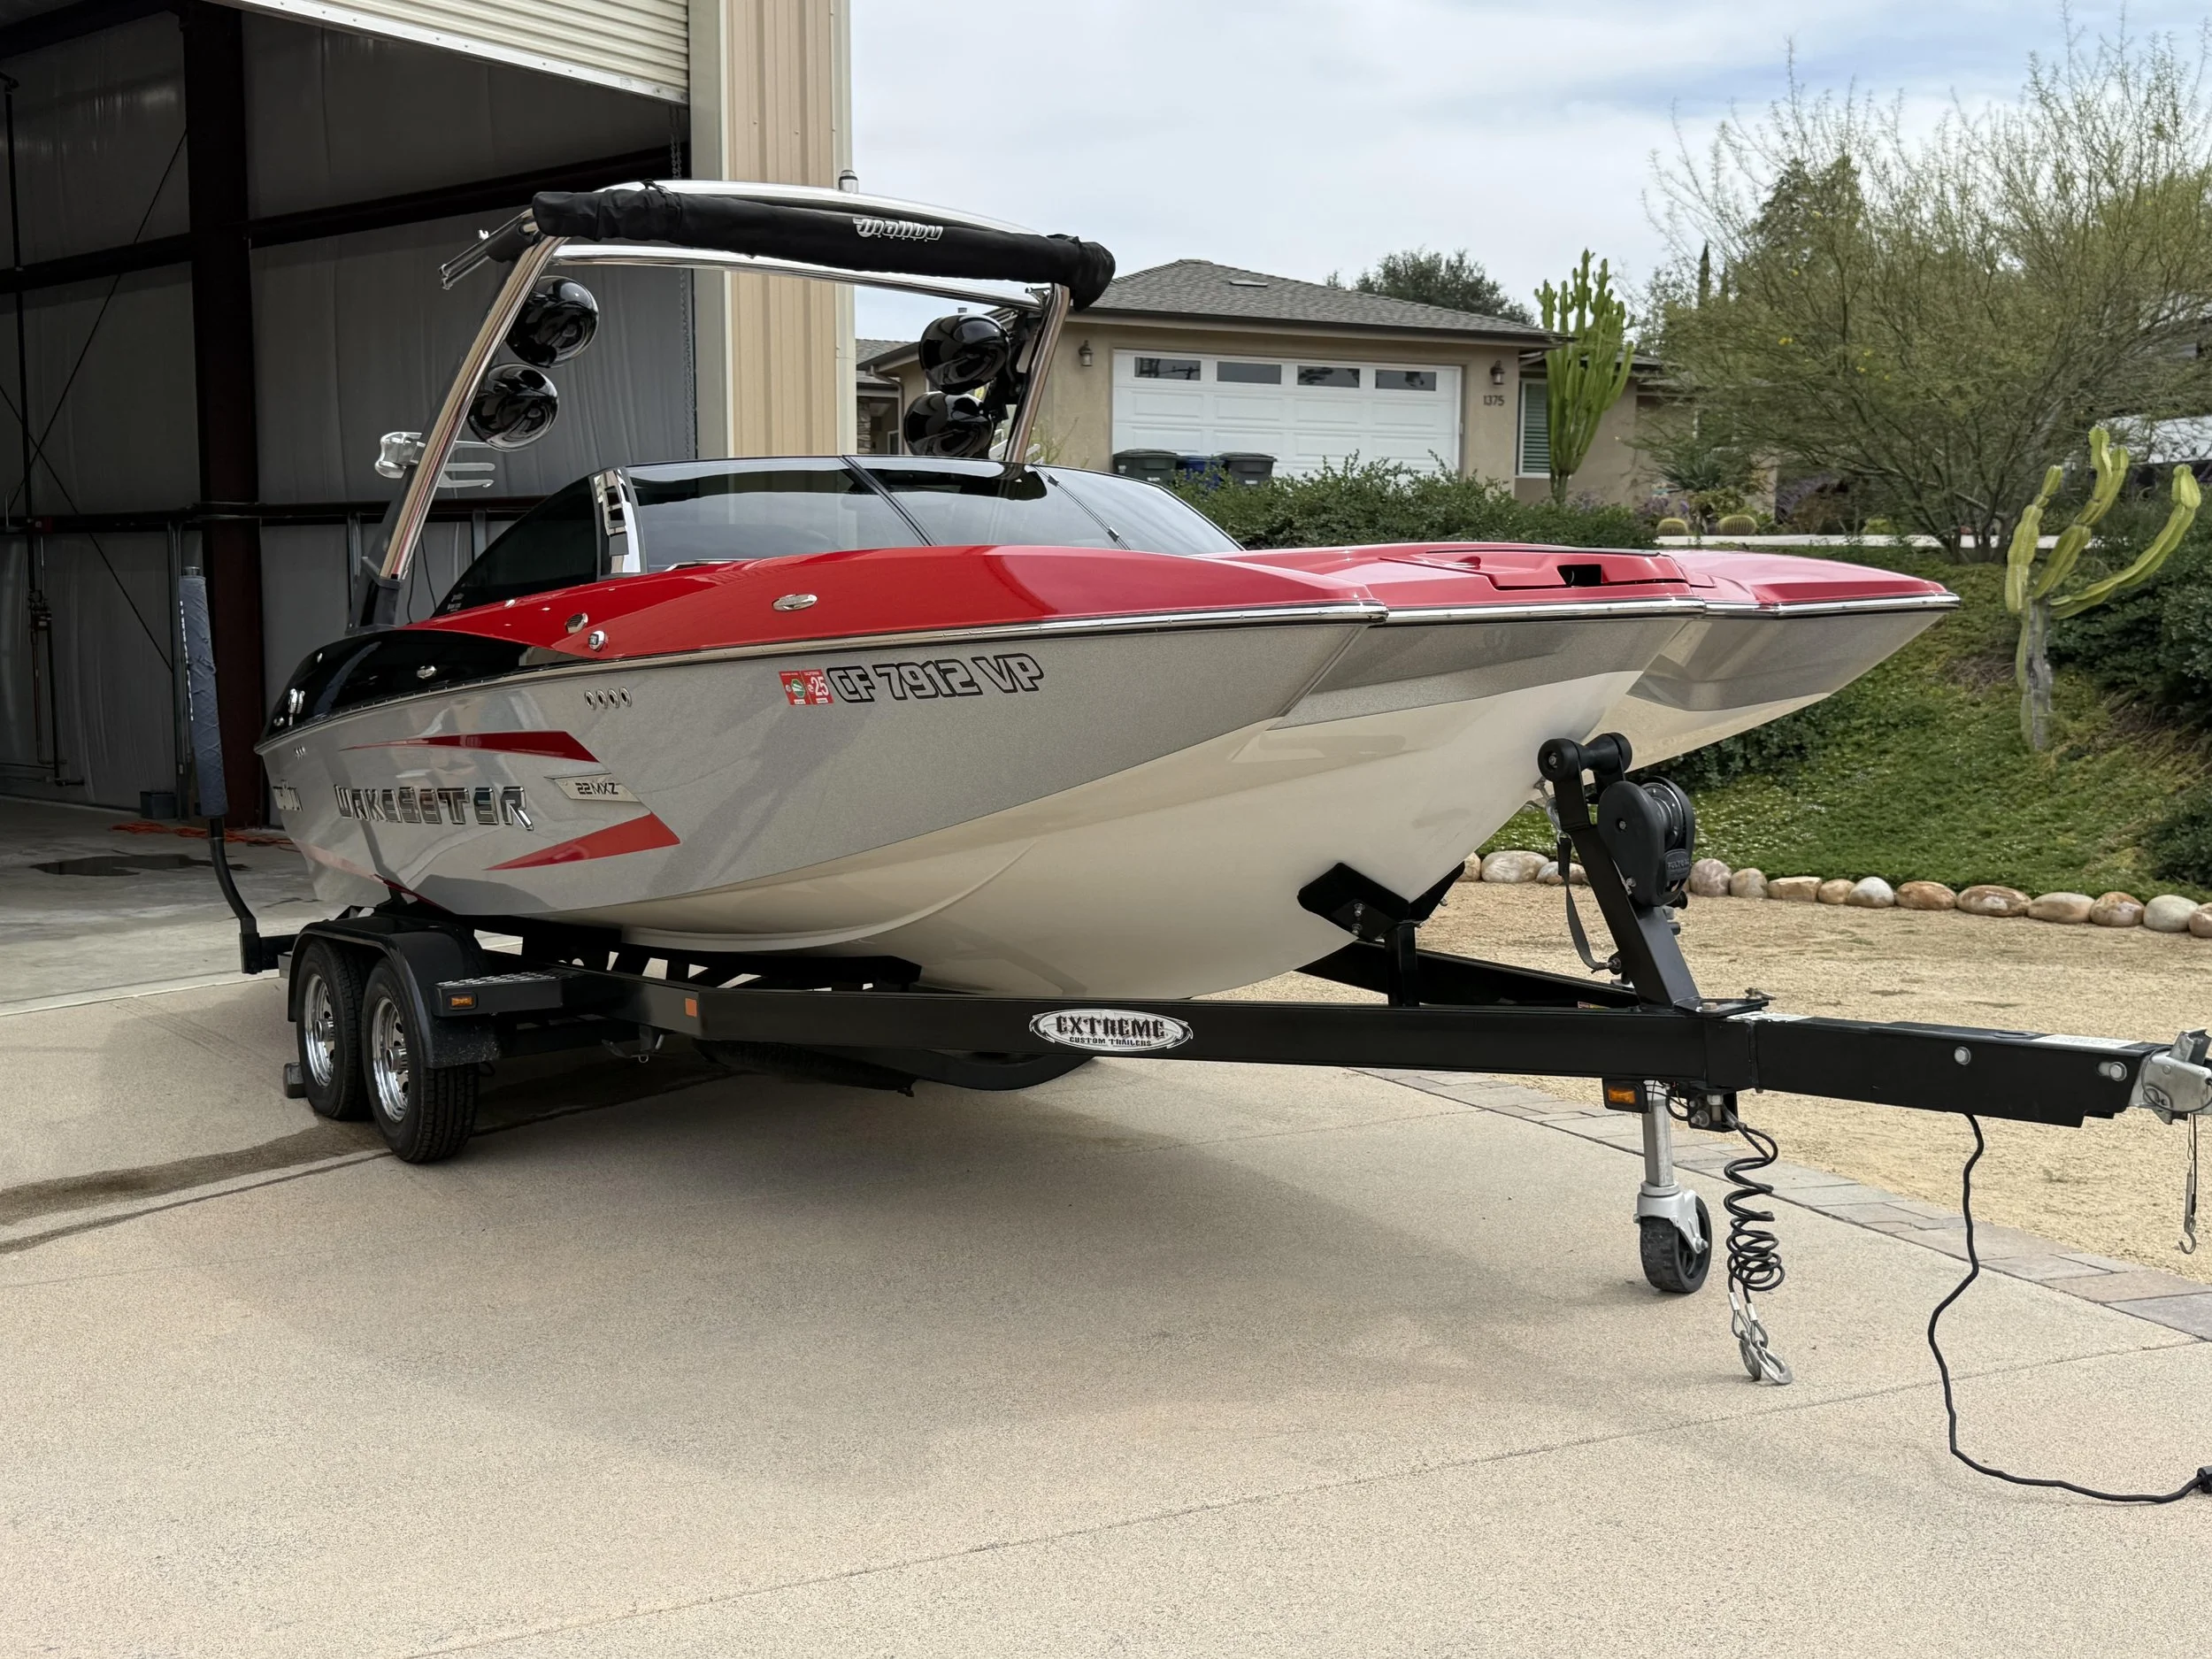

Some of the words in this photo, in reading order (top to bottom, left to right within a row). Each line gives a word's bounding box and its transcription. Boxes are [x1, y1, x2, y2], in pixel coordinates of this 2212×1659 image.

[1483, 395, 1505, 406] 1375
[810, 676, 830, 696] 25
[826, 665, 875, 703] CF
[872, 658, 983, 700] 7912
[972, 653, 1045, 693] VP
[575, 782, 618, 795] 22MXZ
[1055, 1015, 1166, 1041] EXTREME
[1108, 1038, 1152, 1047] TRAILERS
